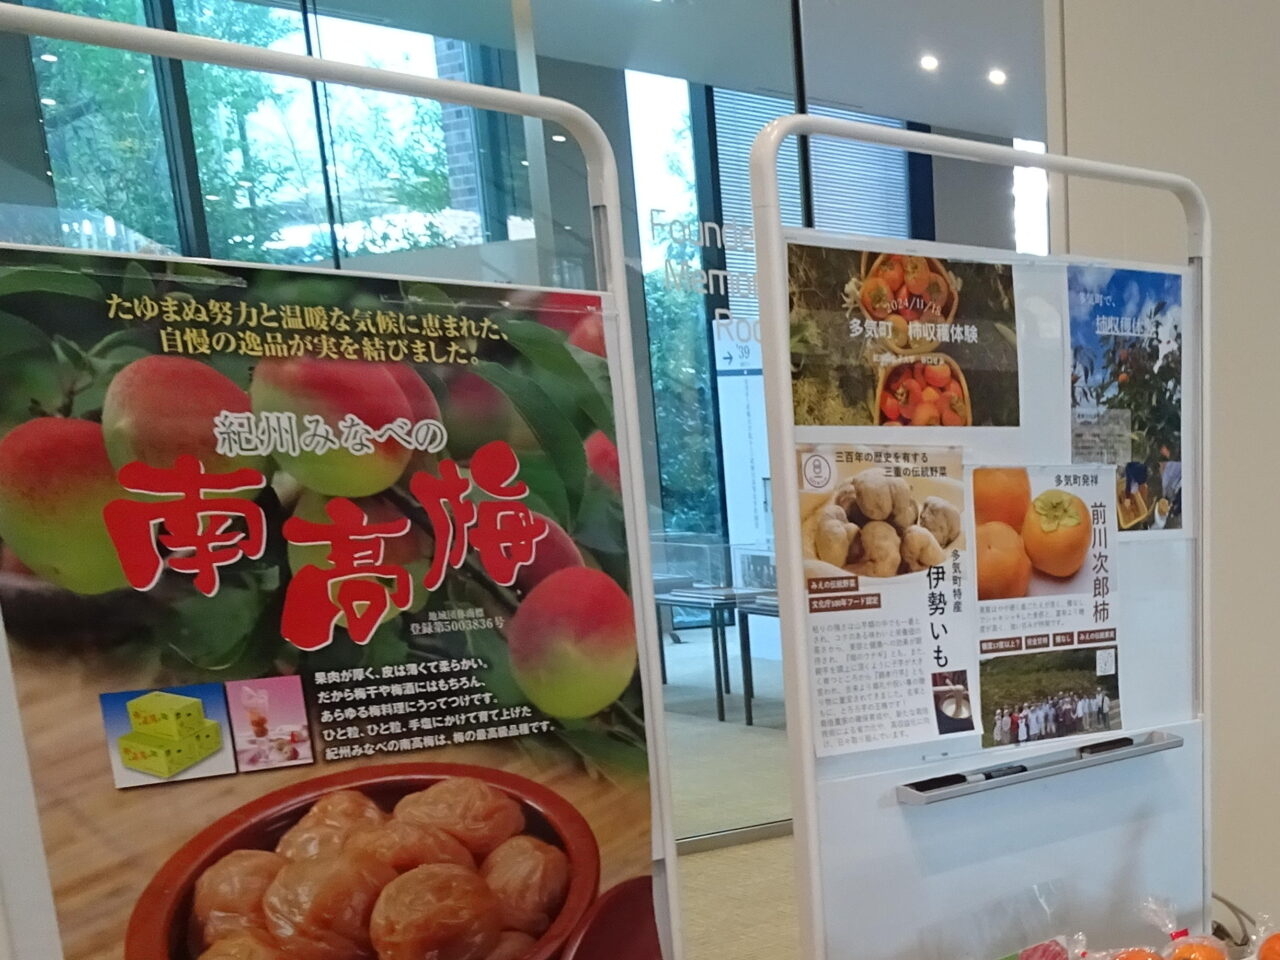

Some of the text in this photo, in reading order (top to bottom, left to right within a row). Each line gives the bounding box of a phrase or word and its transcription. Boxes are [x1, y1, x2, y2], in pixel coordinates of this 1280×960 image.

[106, 293, 509, 341] たゆまぬ努力と温暖な気候に恵まれた、
[849, 318, 978, 343] 多気町 柿収穫体験
[160, 327, 481, 366] 自慢の逸品が実を結びました。
[214, 411, 448, 457] 紀州みなべの
[835, 450, 929, 463] 三百年の歴史を有する
[883, 466, 948, 478] 三重の伝統野菜
[1054, 474, 1099, 487] 多気町発祥
[103, 440, 549, 651] 南高梅
[1091, 501, 1110, 624] 前川次郎柿
[951, 549, 963, 614] 多気町特産
[926, 565, 949, 668] 伊勢いも
[314, 657, 489, 685] 果肉が厚く、皮は薄くて柔らかい。
[317, 675, 486, 704] だから梅干や梅酒にはもちろん、
[320, 693, 499, 724] あらゆる梅料理にうってつけです。
